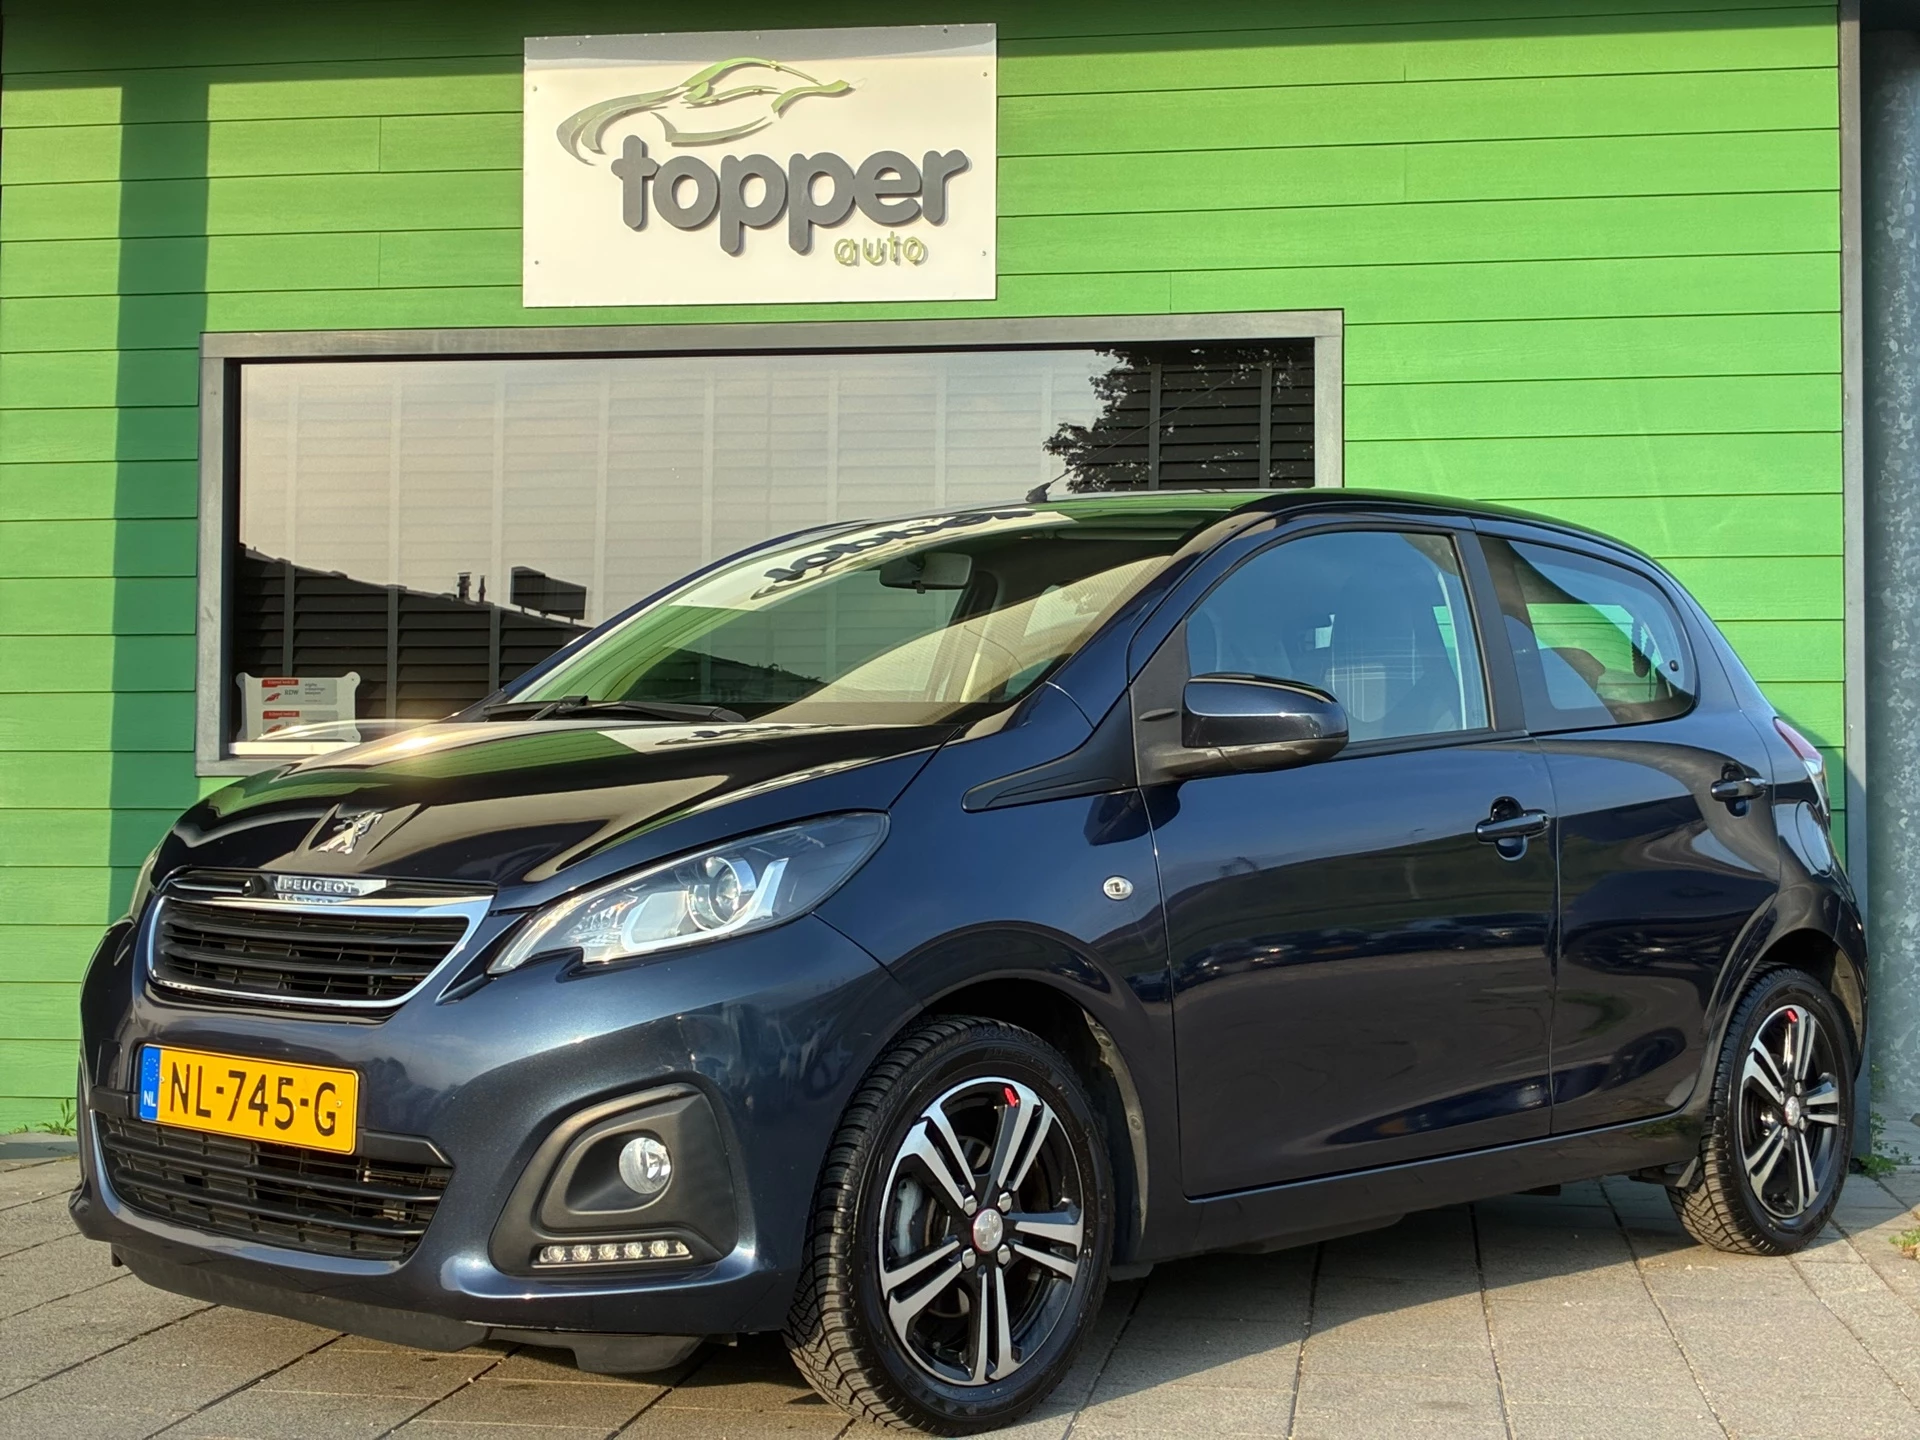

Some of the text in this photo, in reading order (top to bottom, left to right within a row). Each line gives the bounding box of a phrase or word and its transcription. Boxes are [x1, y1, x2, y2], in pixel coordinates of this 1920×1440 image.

[611, 134, 969, 256] topper
[834, 231, 925, 265] auto
[283, 880, 353, 893] PEUGEOT
[143, 1090, 157, 1107] NL
[170, 1061, 336, 1137] NL-745-G
